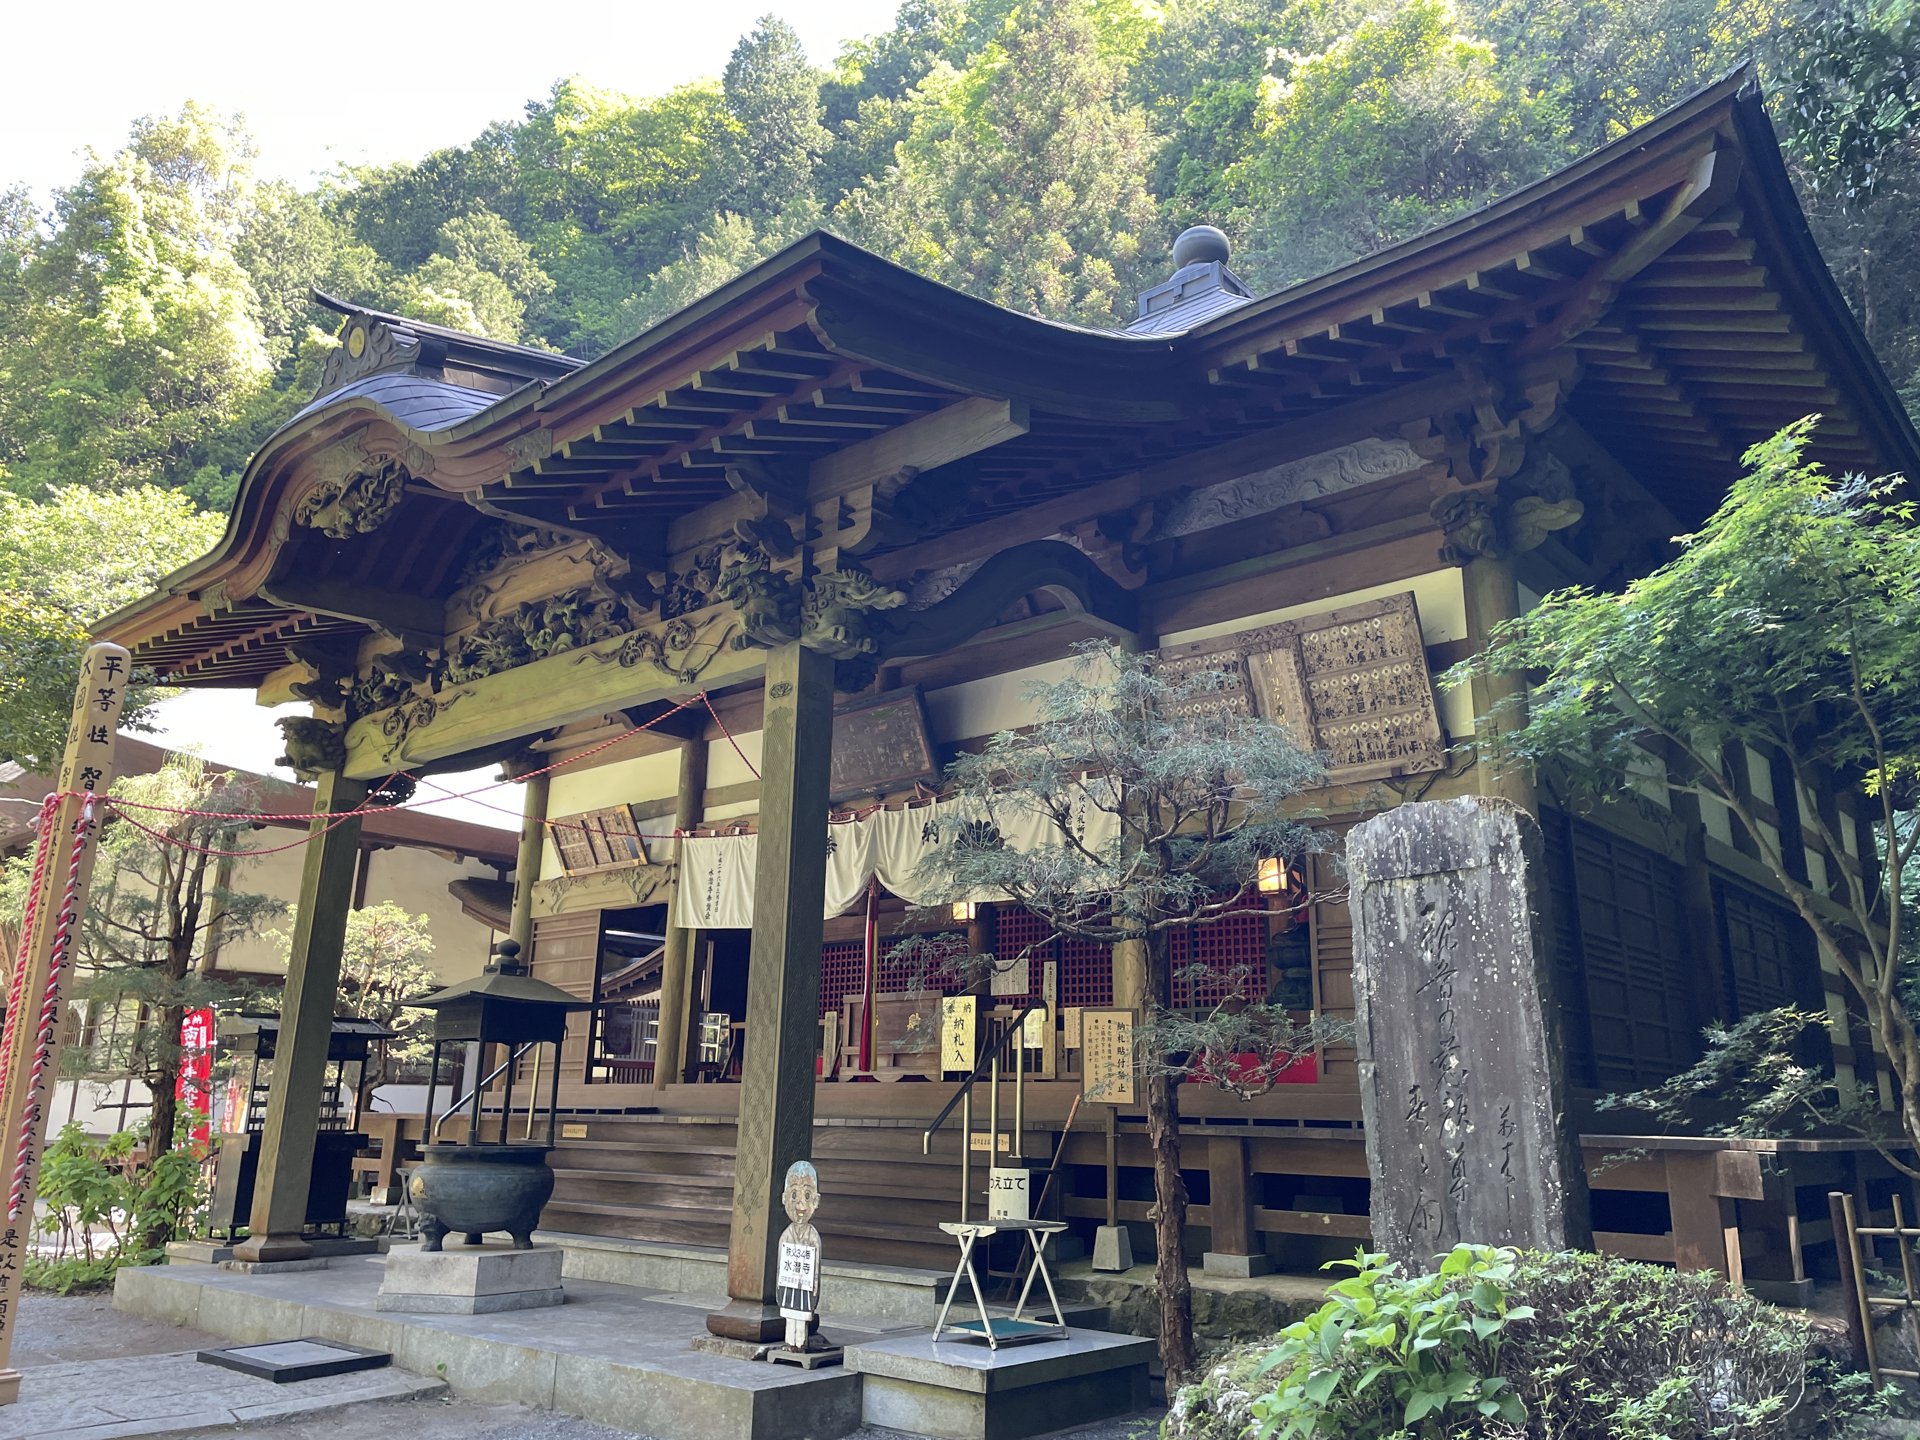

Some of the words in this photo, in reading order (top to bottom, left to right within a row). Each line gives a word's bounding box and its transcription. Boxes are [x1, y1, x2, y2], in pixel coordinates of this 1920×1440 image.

[79, 656, 124, 791] 平等性智
[953, 1016, 965, 1063] 納札入
[1117, 1021, 1127, 1093] 納札貼付禁止
[783, 1259, 811, 1275] 水潜寺
